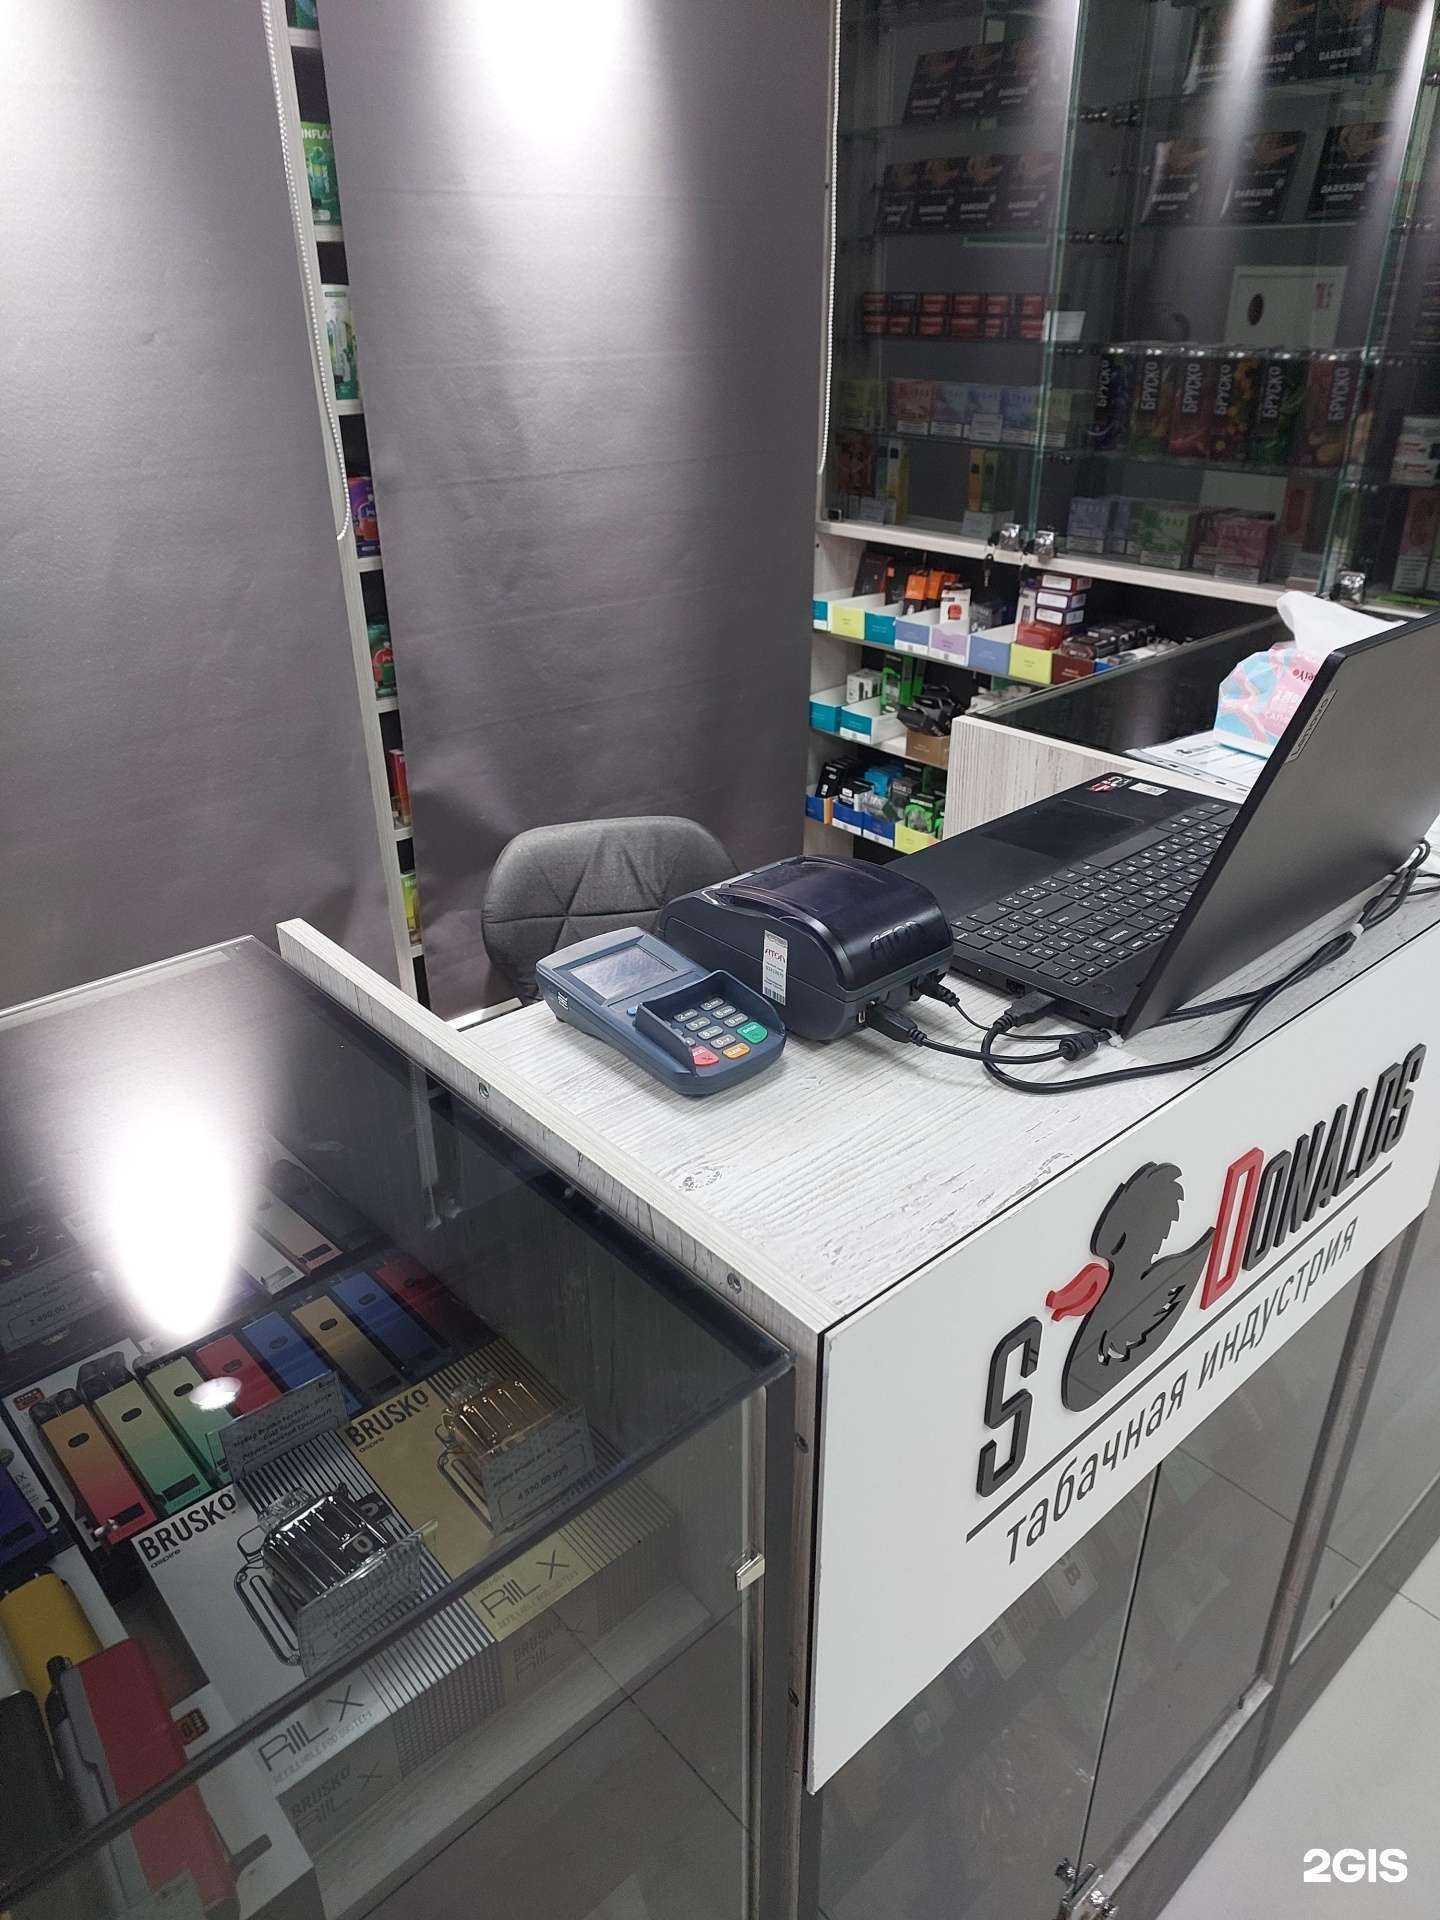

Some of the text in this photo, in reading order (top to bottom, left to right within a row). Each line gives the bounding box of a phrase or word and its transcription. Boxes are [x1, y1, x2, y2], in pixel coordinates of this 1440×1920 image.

[1141, 362, 1158, 411] БРУСКО
[1182, 363, 1201, 414] БРУСКО
[1215, 364, 1232, 416] БРУСКО
[1263, 366, 1282, 418] БРУСКО
[1328, 367, 1350, 421] БРУСКО
[346, 1388, 430, 1448] BRUSKO
[976, 1316, 1042, 1497] S
[1007, 1216, 1360, 1565] табачная индустрия
[138, 1492, 237, 1562] BRUSKO
[151, 1549, 181, 1569] aspire
[480, 1579, 542, 1619] RIIL
[535, 1549, 570, 1580] X
[257, 1720, 330, 1771] RIIL
[328, 1684, 364, 1722] X
